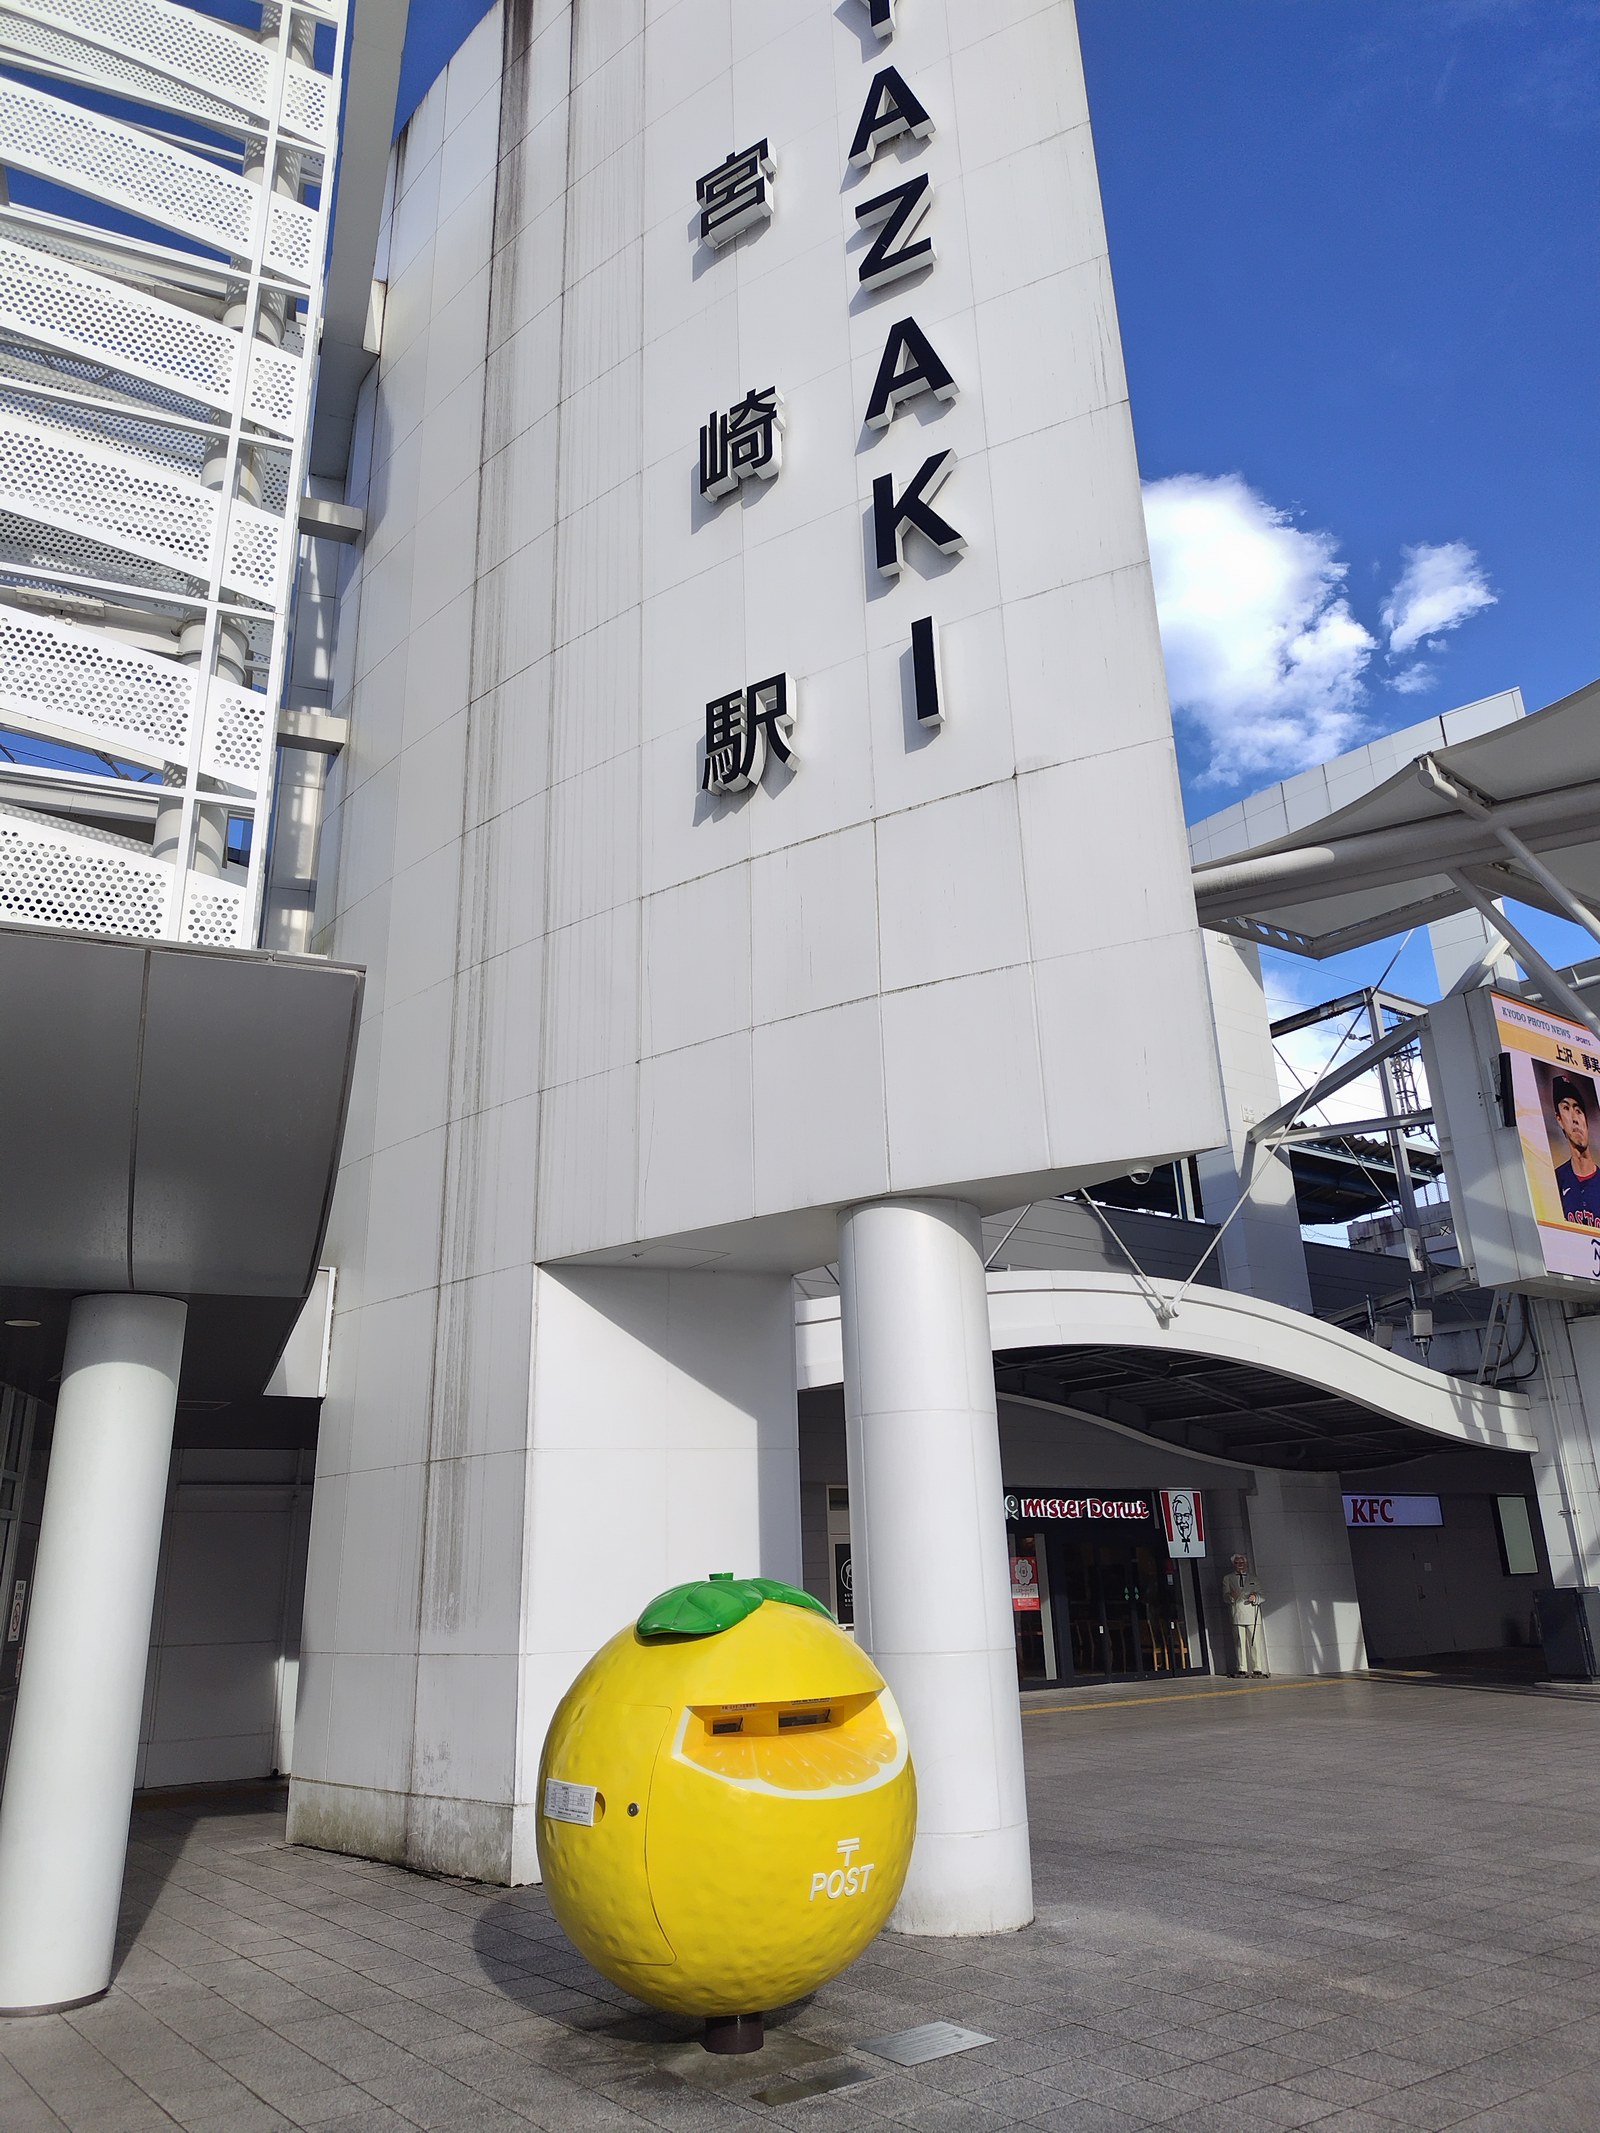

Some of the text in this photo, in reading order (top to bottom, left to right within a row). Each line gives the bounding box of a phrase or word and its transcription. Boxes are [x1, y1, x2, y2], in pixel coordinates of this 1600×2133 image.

[695, 137, 792, 791] 宮崎駅
[1501, 1006, 1527, 1023] KYODO
[1526, 1016, 1551, 1032] PHOTO
[1550, 1024, 1571, 1039] NEWS
[1086, 1498, 1150, 1519] Donut
[1350, 1498, 1394, 1523] KFC
[808, 1863, 875, 1902] POST
